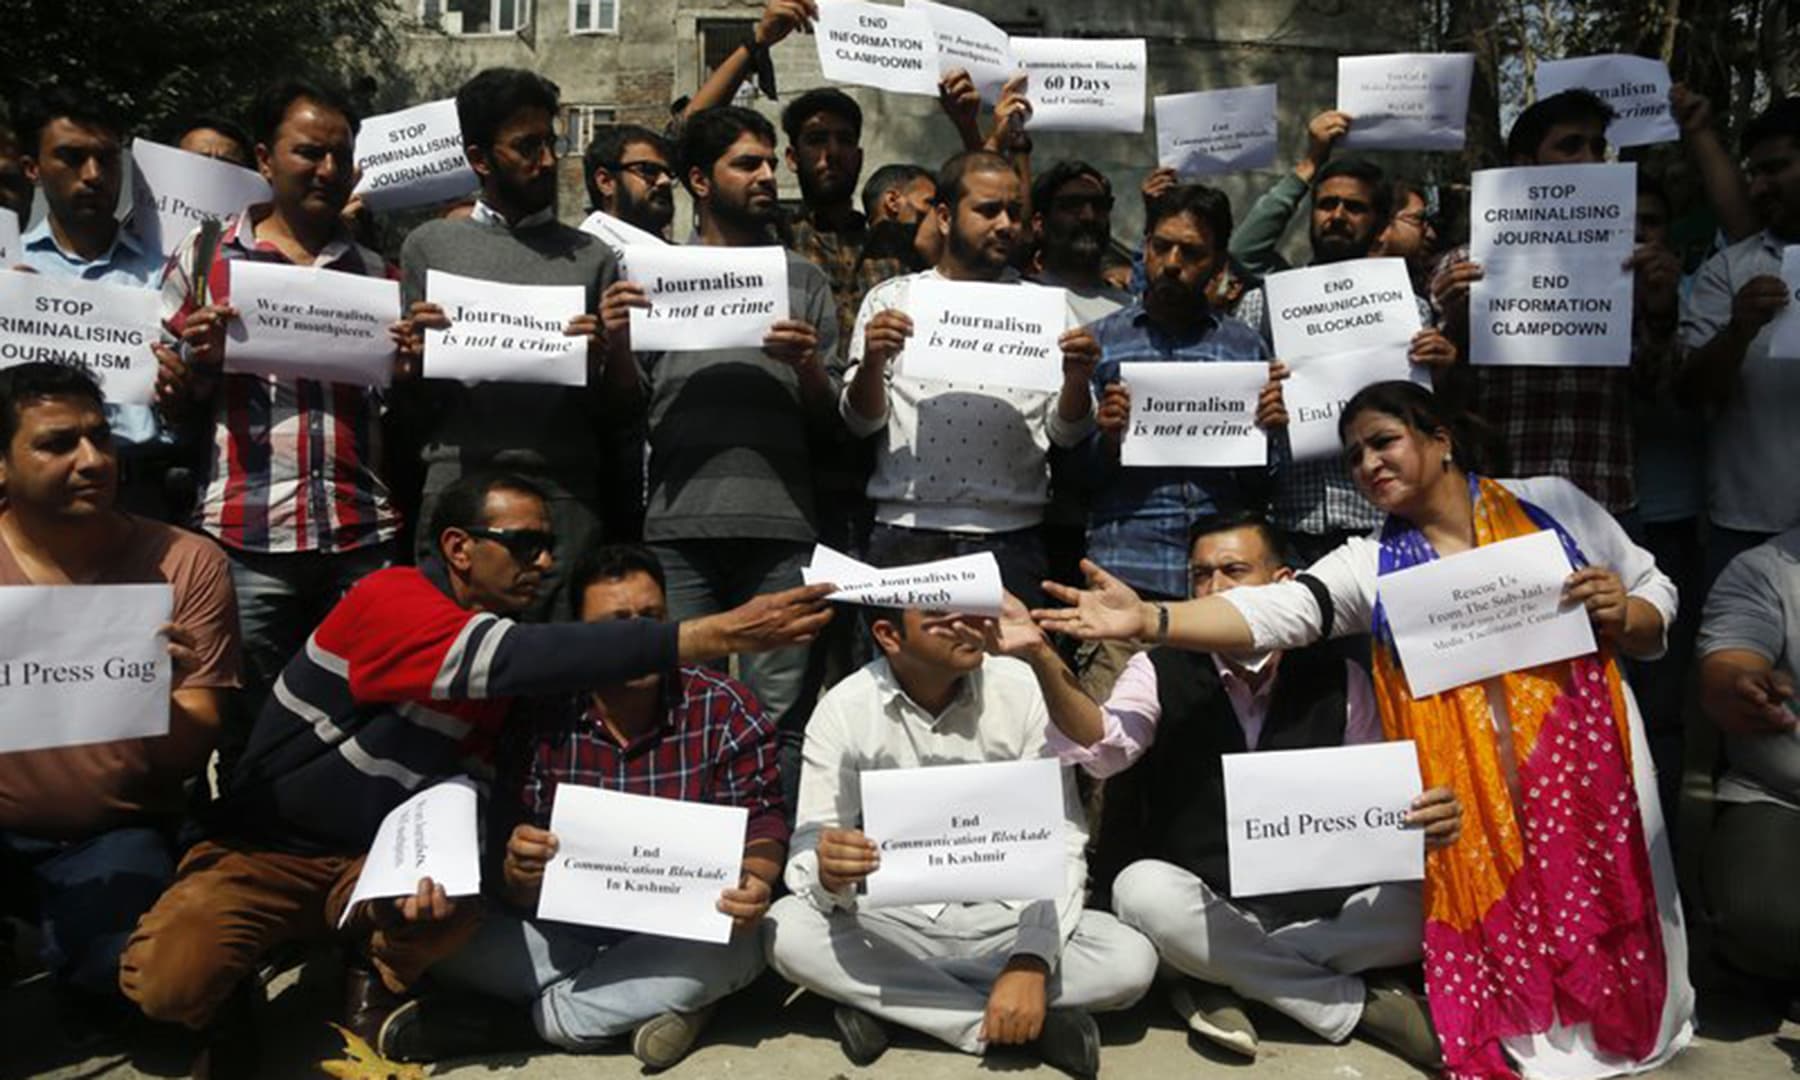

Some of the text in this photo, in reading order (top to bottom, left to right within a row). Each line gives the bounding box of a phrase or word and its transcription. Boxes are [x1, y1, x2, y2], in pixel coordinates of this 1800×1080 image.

[859, 15, 887, 29] END
[829, 30, 922, 51] INFORMATION
[835, 49, 922, 70] CLAMPDOWN
[1044, 76, 1111, 95] 60 Days
[388, 123, 427, 143] STOP
[370, 156, 466, 188] JOURNALISM
[1528, 184, 1576, 200] STOP
[1484, 204, 1621, 223] CRIMINALISING
[1493, 228, 1610, 246] JOURNALISM
[652, 271, 764, 294] Journalism
[1324, 278, 1354, 294] END
[1532, 275, 1570, 289] END
[35, 296, 93, 316] STOP
[256, 298, 379, 323] We are Journalists,
[668, 303, 699, 319] not
[704, 304, 715, 316] a
[720, 297, 774, 316] crime
[1281, 290, 1403, 321] COMMUNICATION
[1488, 298, 1612, 313] INFORMATION
[257, 314, 375, 338] NOT mouthpieces.
[452, 306, 562, 332] Journalism
[938, 309, 1042, 335] Journalism
[1306, 311, 1384, 336] BLOCKADE
[1492, 321, 1608, 337] CLAMPDOWN
[0, 317, 143, 346] RIMINALISING
[442, 331, 572, 353] is not a crime
[928, 331, 1049, 359] is not a crime
[1, 343, 131, 370] OURNALISM
[1142, 397, 1246, 413] Journalism
[1298, 402, 1333, 423] End
[1133, 420, 1253, 437] is not a crime
[878, 571, 959, 587] Journalists
[961, 570, 977, 581] to
[1451, 575, 1519, 602] Rescue Us
[907, 589, 952, 604] Freely
[1428, 610, 1464, 626] From
[1465, 599, 1490, 616] The
[23, 662, 95, 685] Press
[103, 657, 157, 684] Gag
[951, 815, 980, 829] End
[1245, 815, 1291, 840] End
[1298, 813, 1358, 835] Press
[881, 828, 1052, 851] Communication Blockade
[632, 845, 660, 858] End
[928, 850, 1007, 866] In Kashmir
[564, 857, 728, 880] Communication Blockade
[606, 878, 683, 895] In Kashmir
